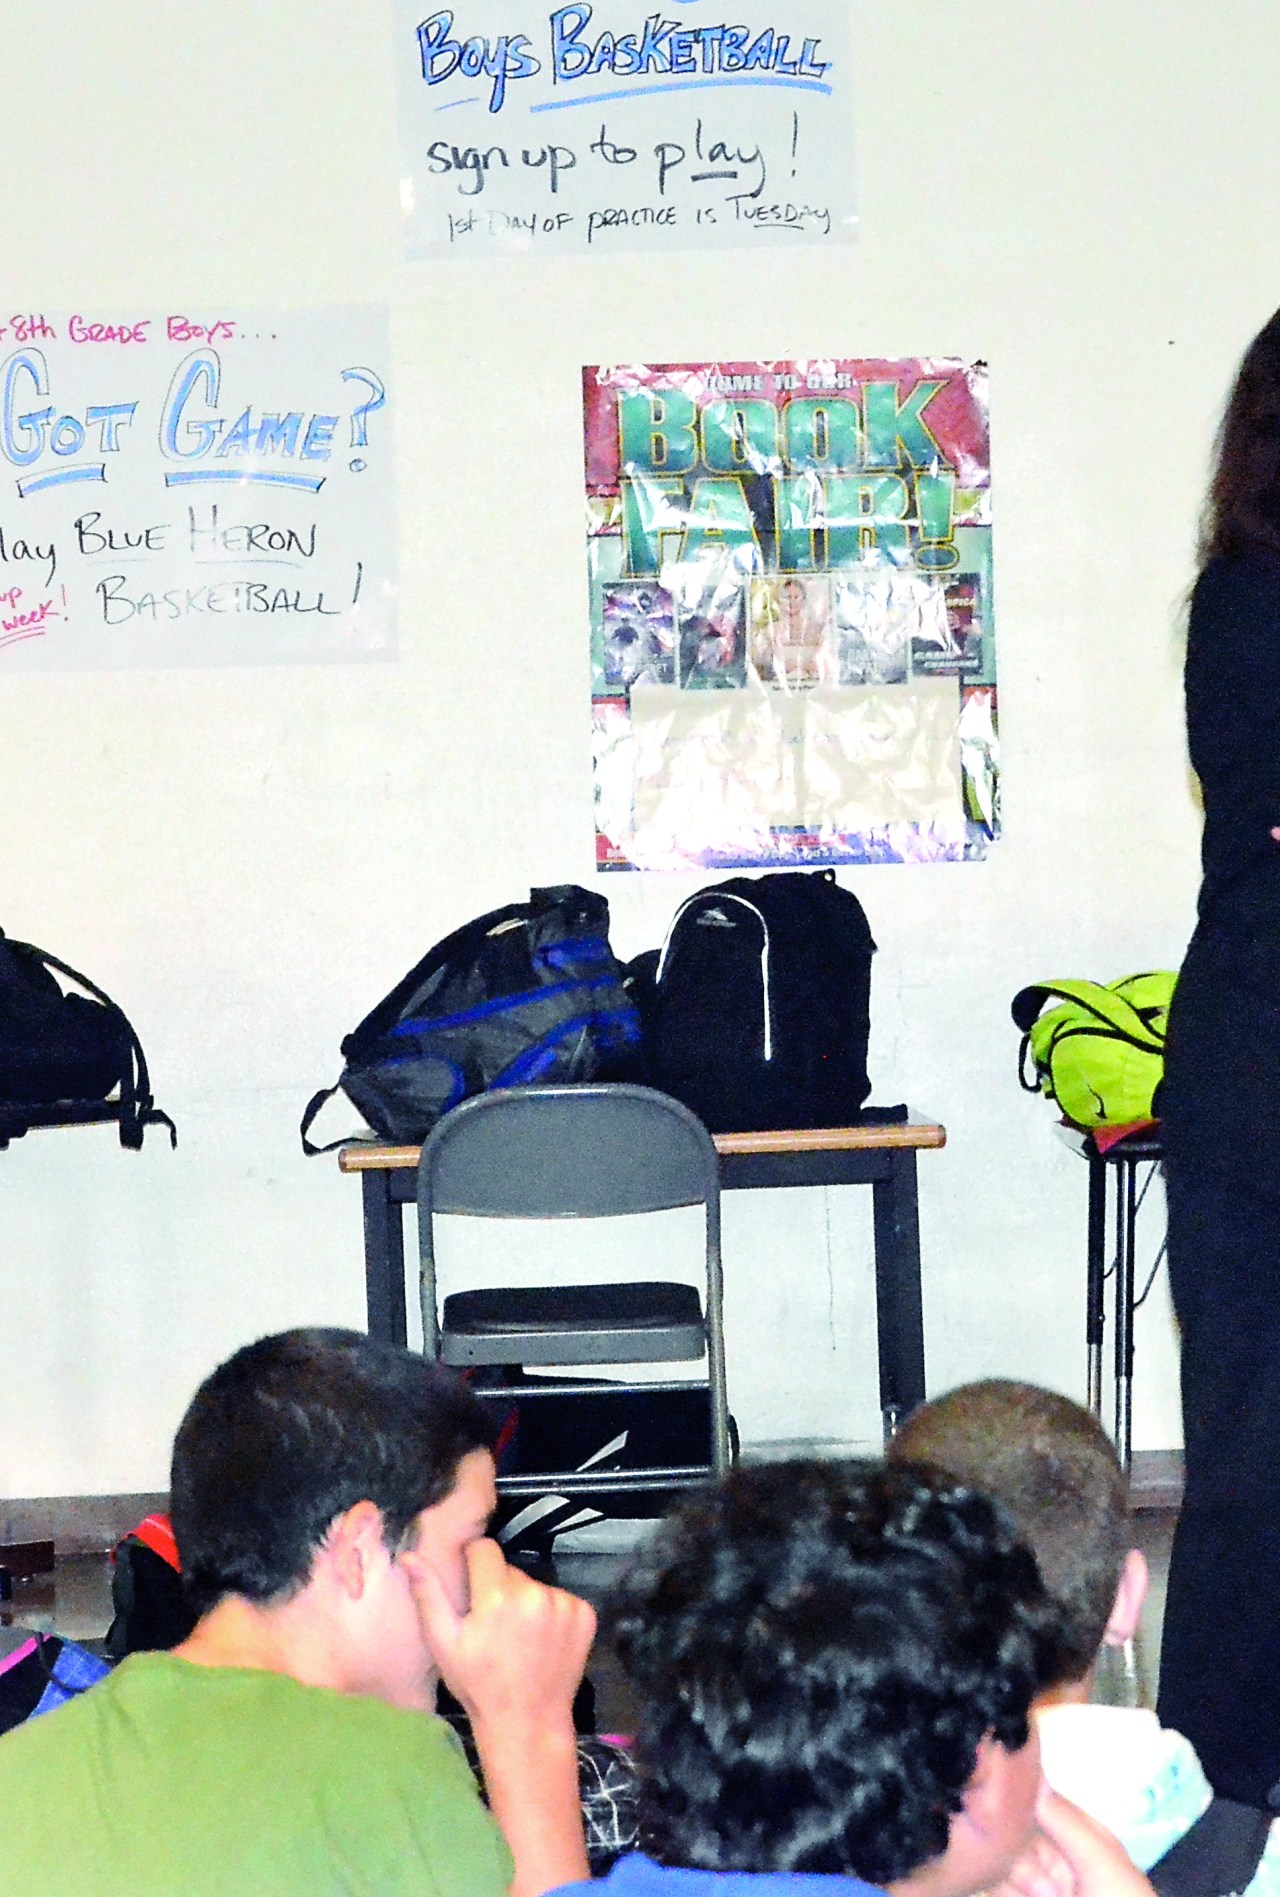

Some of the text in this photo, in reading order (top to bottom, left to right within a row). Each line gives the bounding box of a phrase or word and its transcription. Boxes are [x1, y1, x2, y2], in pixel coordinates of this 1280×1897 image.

[550, 3, 832, 85] BASKETBALL
[427, 139, 509, 195] sign
[521, 138, 577, 193] up
[590, 124, 638, 164] to
[69, 315, 151, 343] GRADE
[0, 347, 140, 466] GOT
[618, 379, 954, 475] BOOK
[0, 505, 316, 587] lay BLUE HERON
[620, 470, 960, 578] FAIR!
